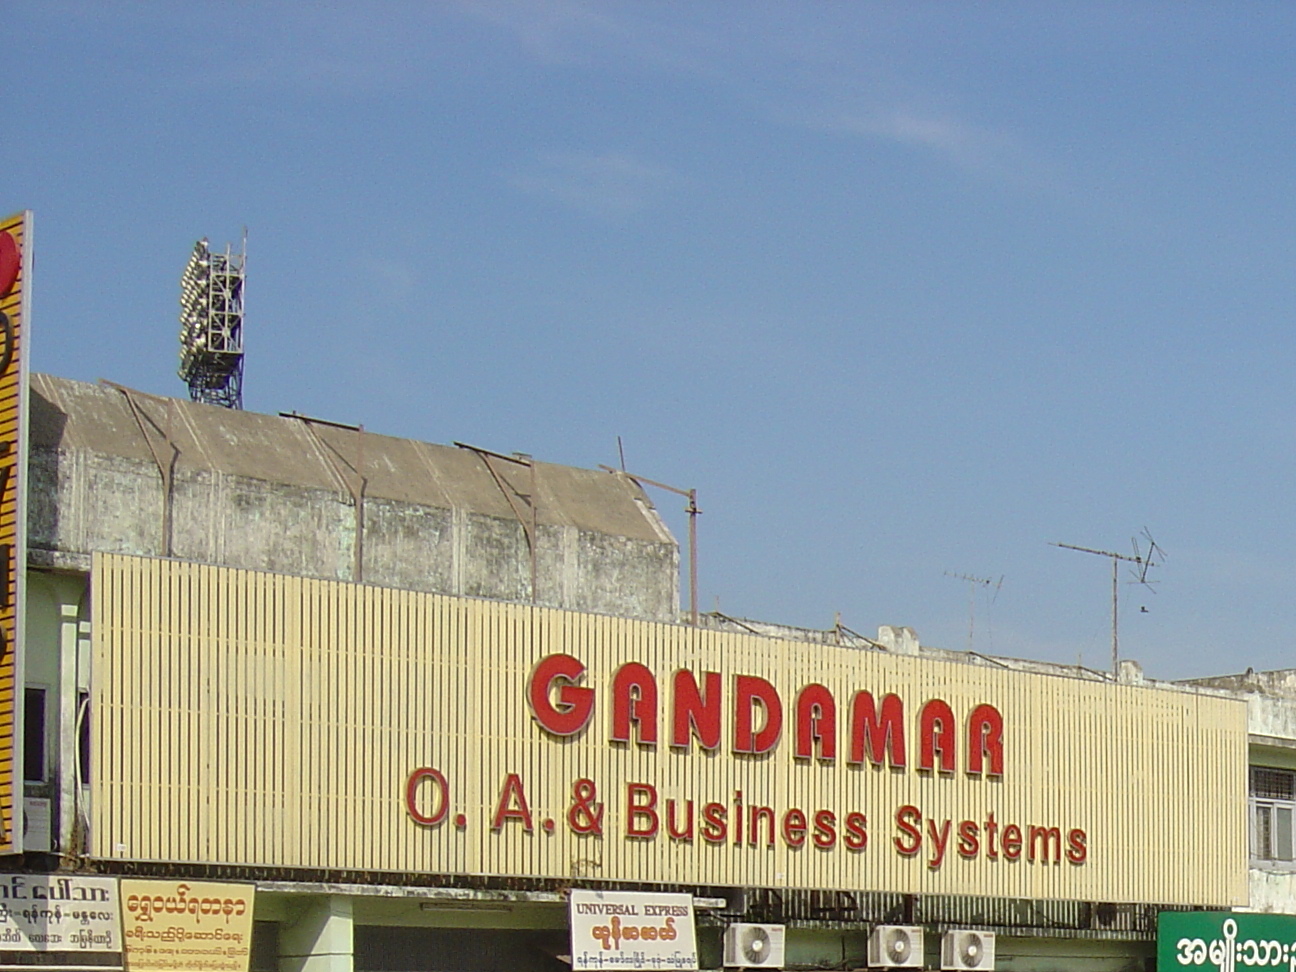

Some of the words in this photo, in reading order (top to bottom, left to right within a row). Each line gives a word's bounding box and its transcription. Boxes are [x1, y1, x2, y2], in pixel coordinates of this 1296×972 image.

[527, 653, 1003, 779] GANDAMAR
[626, 782, 867, 850] Business
[894, 804, 1087, 870] Systems
[576, 903, 639, 916] UNIVERSAL
[644, 905, 688, 917] EXPRESS
